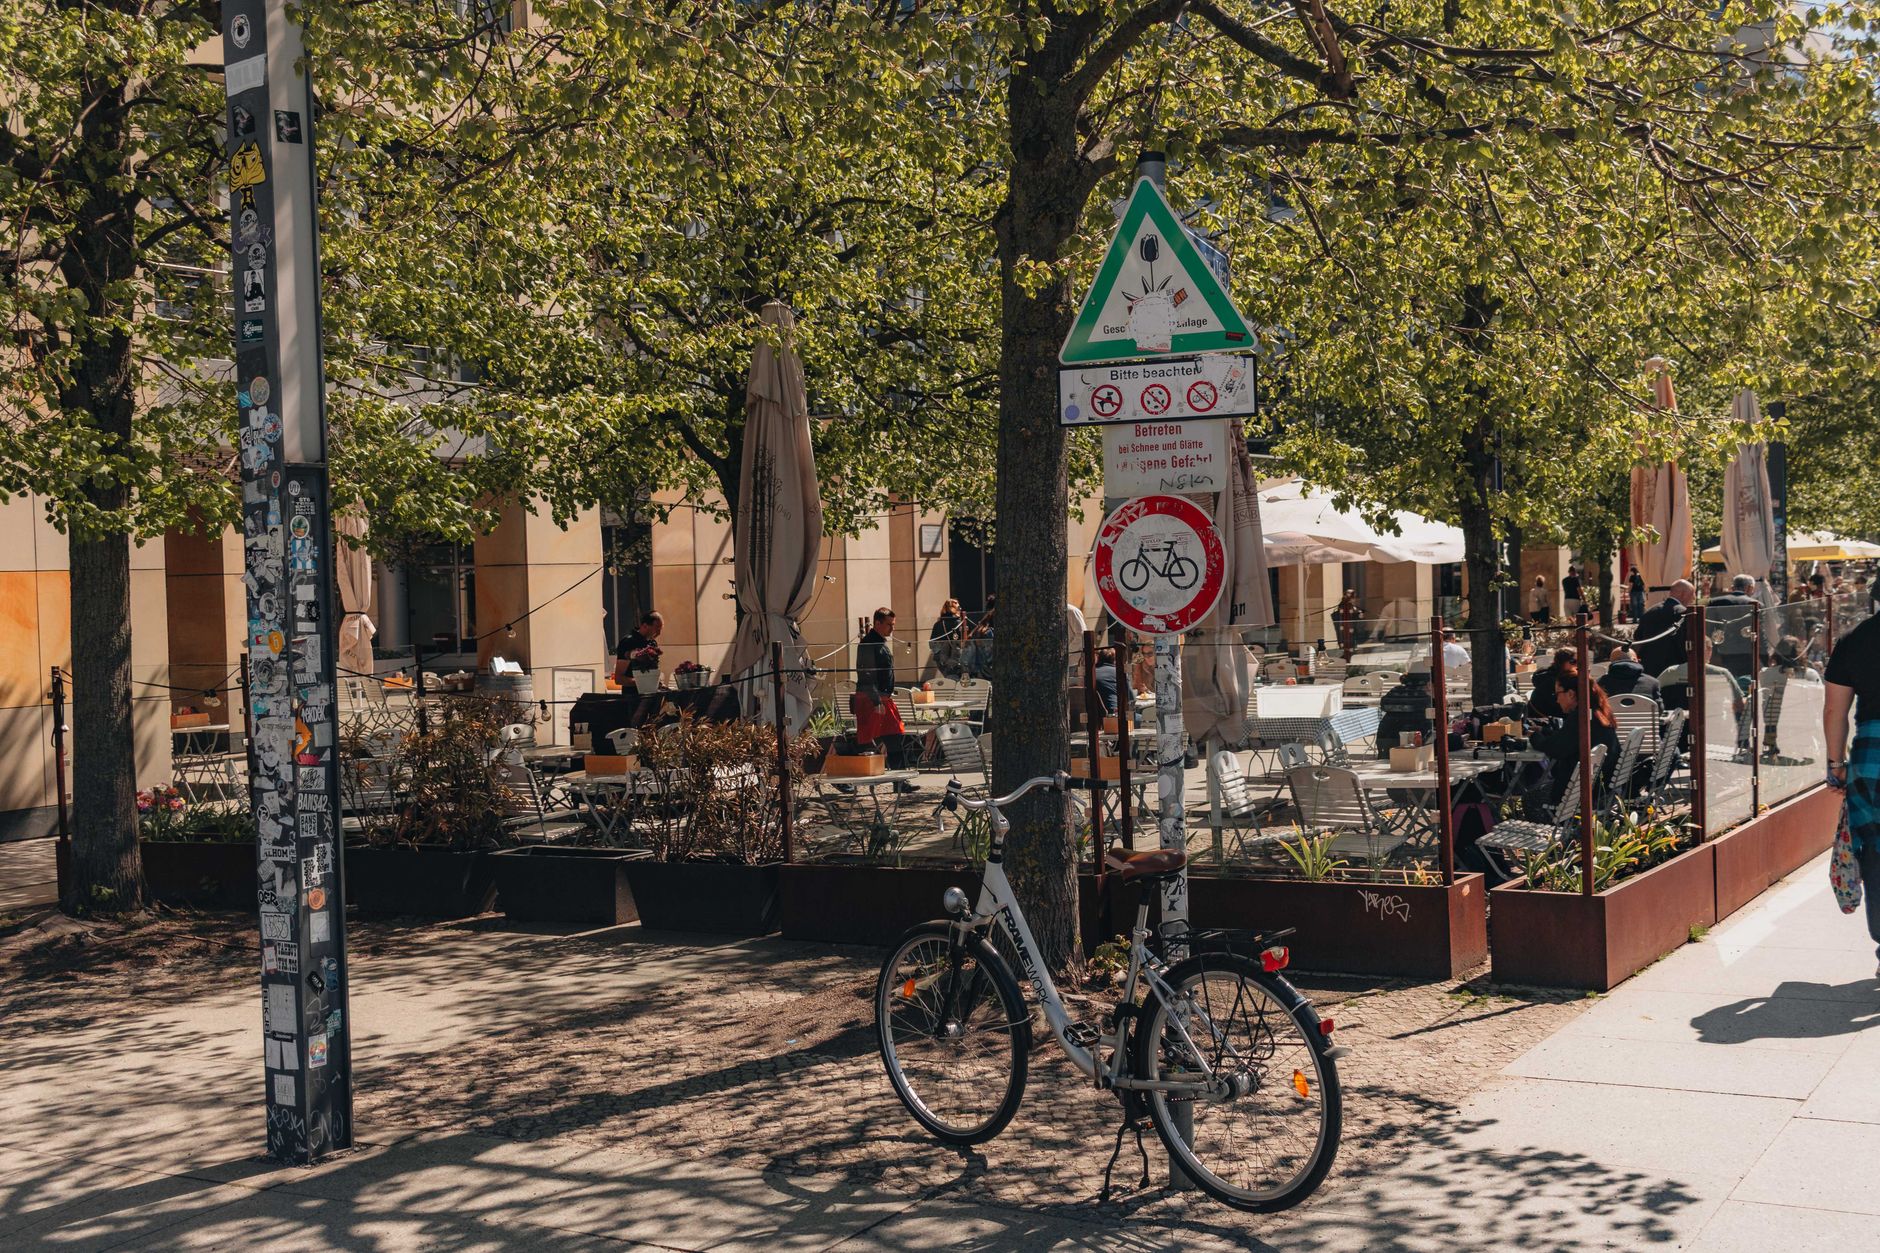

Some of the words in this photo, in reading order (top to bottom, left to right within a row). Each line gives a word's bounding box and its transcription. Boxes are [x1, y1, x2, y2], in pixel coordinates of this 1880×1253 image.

[1110, 368, 1139, 381] Bitte
[1135, 424, 1182, 438] Betreten
[1118, 444, 1129, 454] bei
[1131, 442, 1159, 453] Schnee
[1162, 441, 1177, 451] und
[1179, 440, 1204, 449] Glätte
[1000, 905, 1051, 1008] FRAMEWORK
